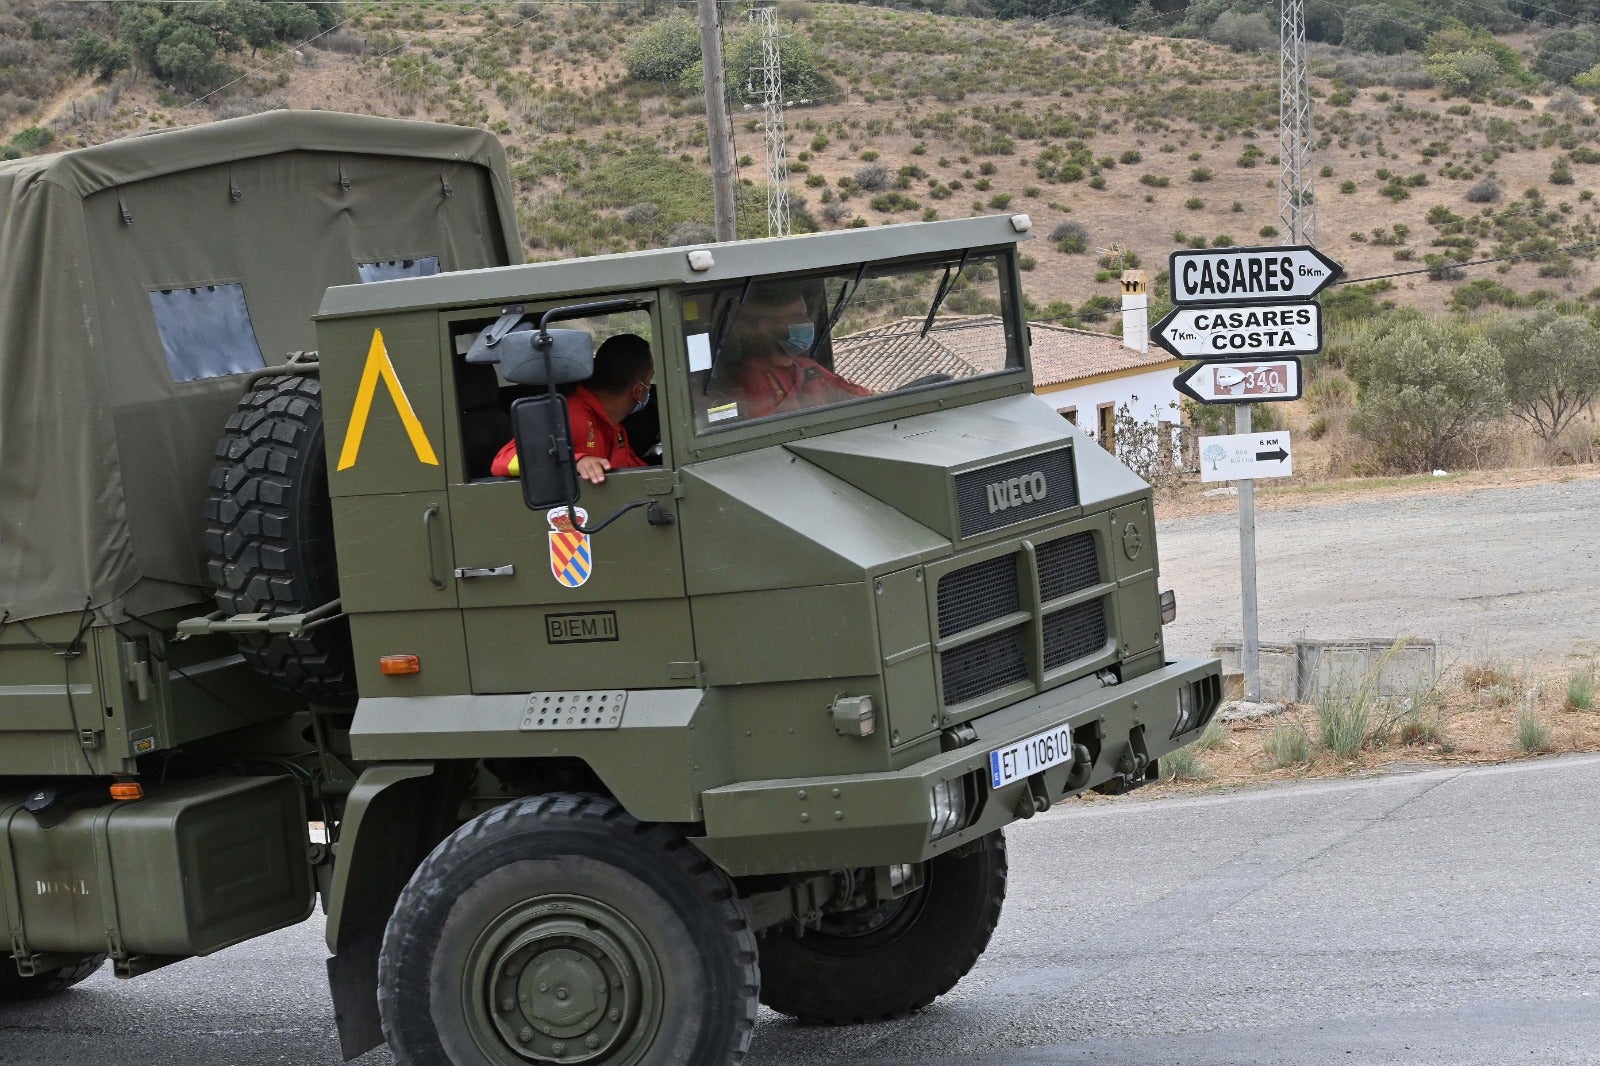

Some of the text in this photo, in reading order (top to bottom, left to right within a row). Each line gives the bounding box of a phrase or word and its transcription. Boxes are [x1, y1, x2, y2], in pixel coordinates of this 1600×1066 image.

[1183, 256, 1325, 296] CASARES 6Km.
[1194, 309, 1311, 331] CASARES
[1170, 329, 1197, 341] 7Km.
[1211, 331, 1296, 350] COSTA
[1266, 438, 1279, 446] KM
[985, 471, 1047, 514] IVECO
[551, 617, 613, 638] BIEM II
[1002, 730, 1069, 780] ET 110610
[36, 880, 89, 895] DISL
